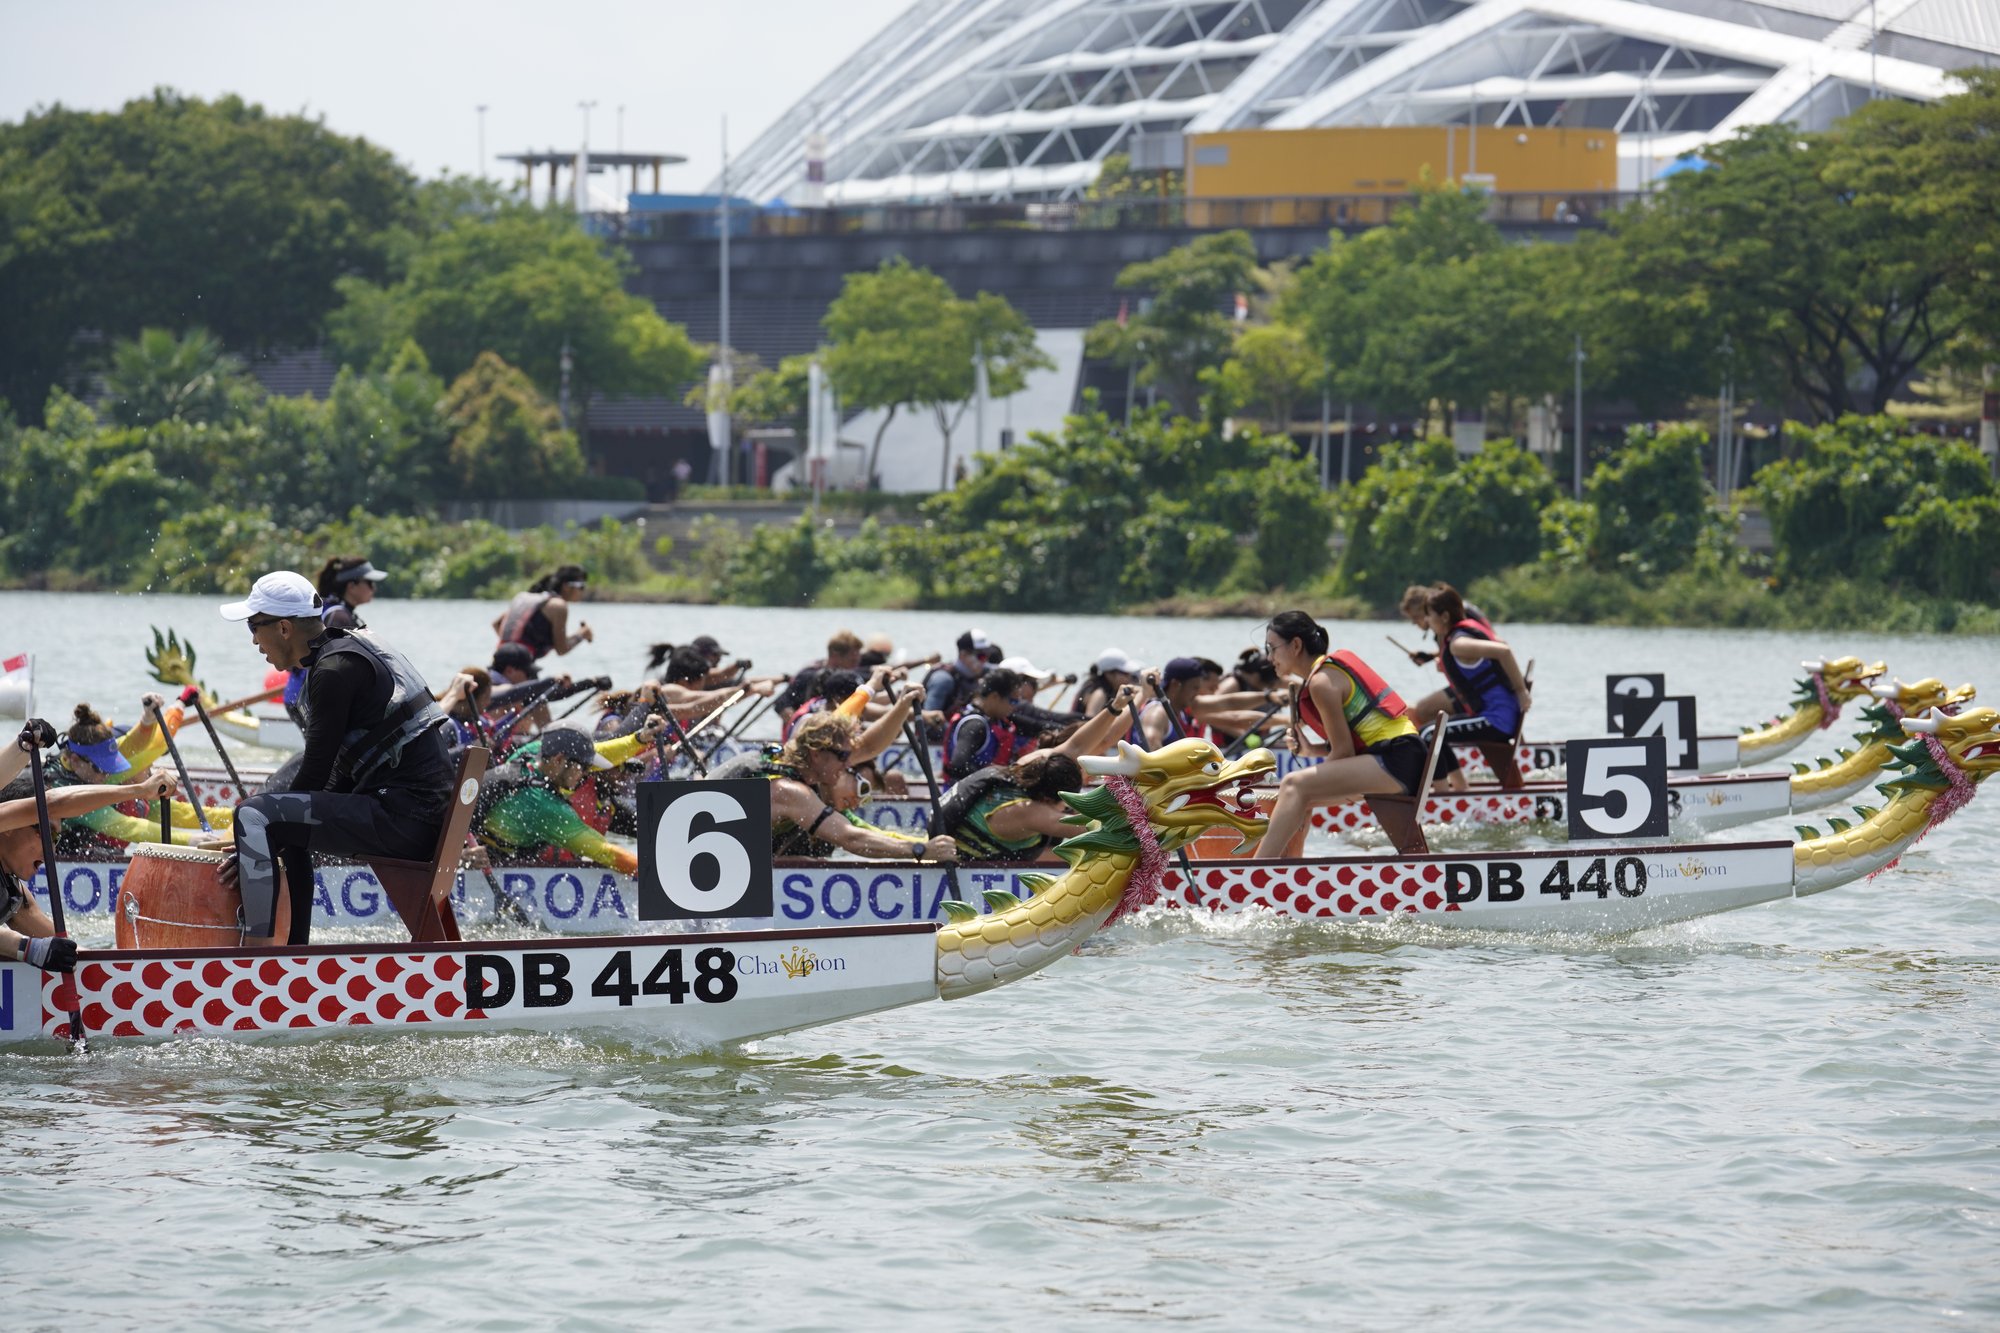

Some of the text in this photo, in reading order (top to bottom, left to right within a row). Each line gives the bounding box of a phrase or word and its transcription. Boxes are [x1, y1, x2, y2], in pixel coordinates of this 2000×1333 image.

[1634, 700, 1688, 767] 4
[1579, 745, 1652, 835] 5
[655, 790, 752, 913] 6
[1444, 861, 1525, 904] DB
[1539, 856, 1648, 901] 440
[464, 953, 574, 1010] DB
[591, 947, 738, 1006] 448
